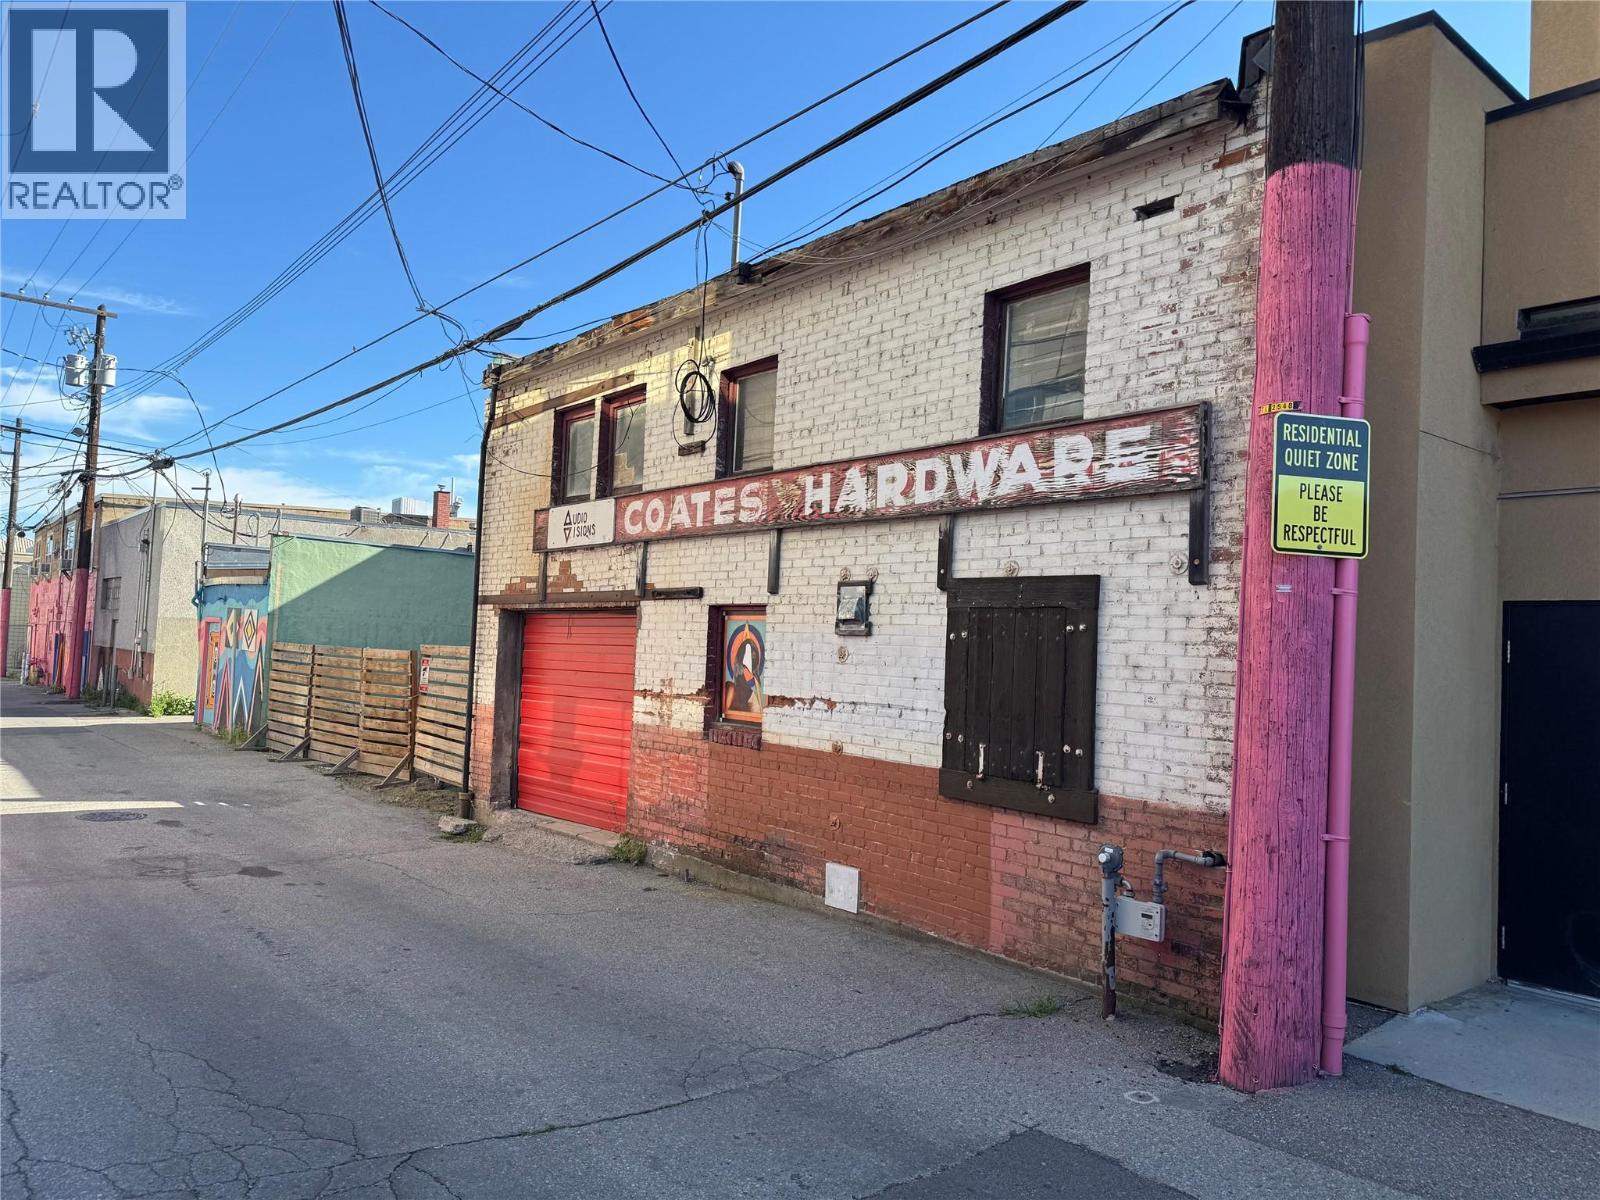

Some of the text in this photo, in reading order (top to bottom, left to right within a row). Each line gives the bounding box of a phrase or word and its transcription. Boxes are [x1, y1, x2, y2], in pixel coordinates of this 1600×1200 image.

[1283, 423, 1362, 448] RESIDENTIAL
[1284, 448, 1359, 472] QUIET ZONE
[624, 425, 1159, 535] COATES HARDWARE
[1299, 483, 1343, 502] PLEASE
[563, 509, 588, 527] AUDIO
[1313, 506, 1328, 522] BE
[1283, 524, 1356, 546] RESPECTFUL
